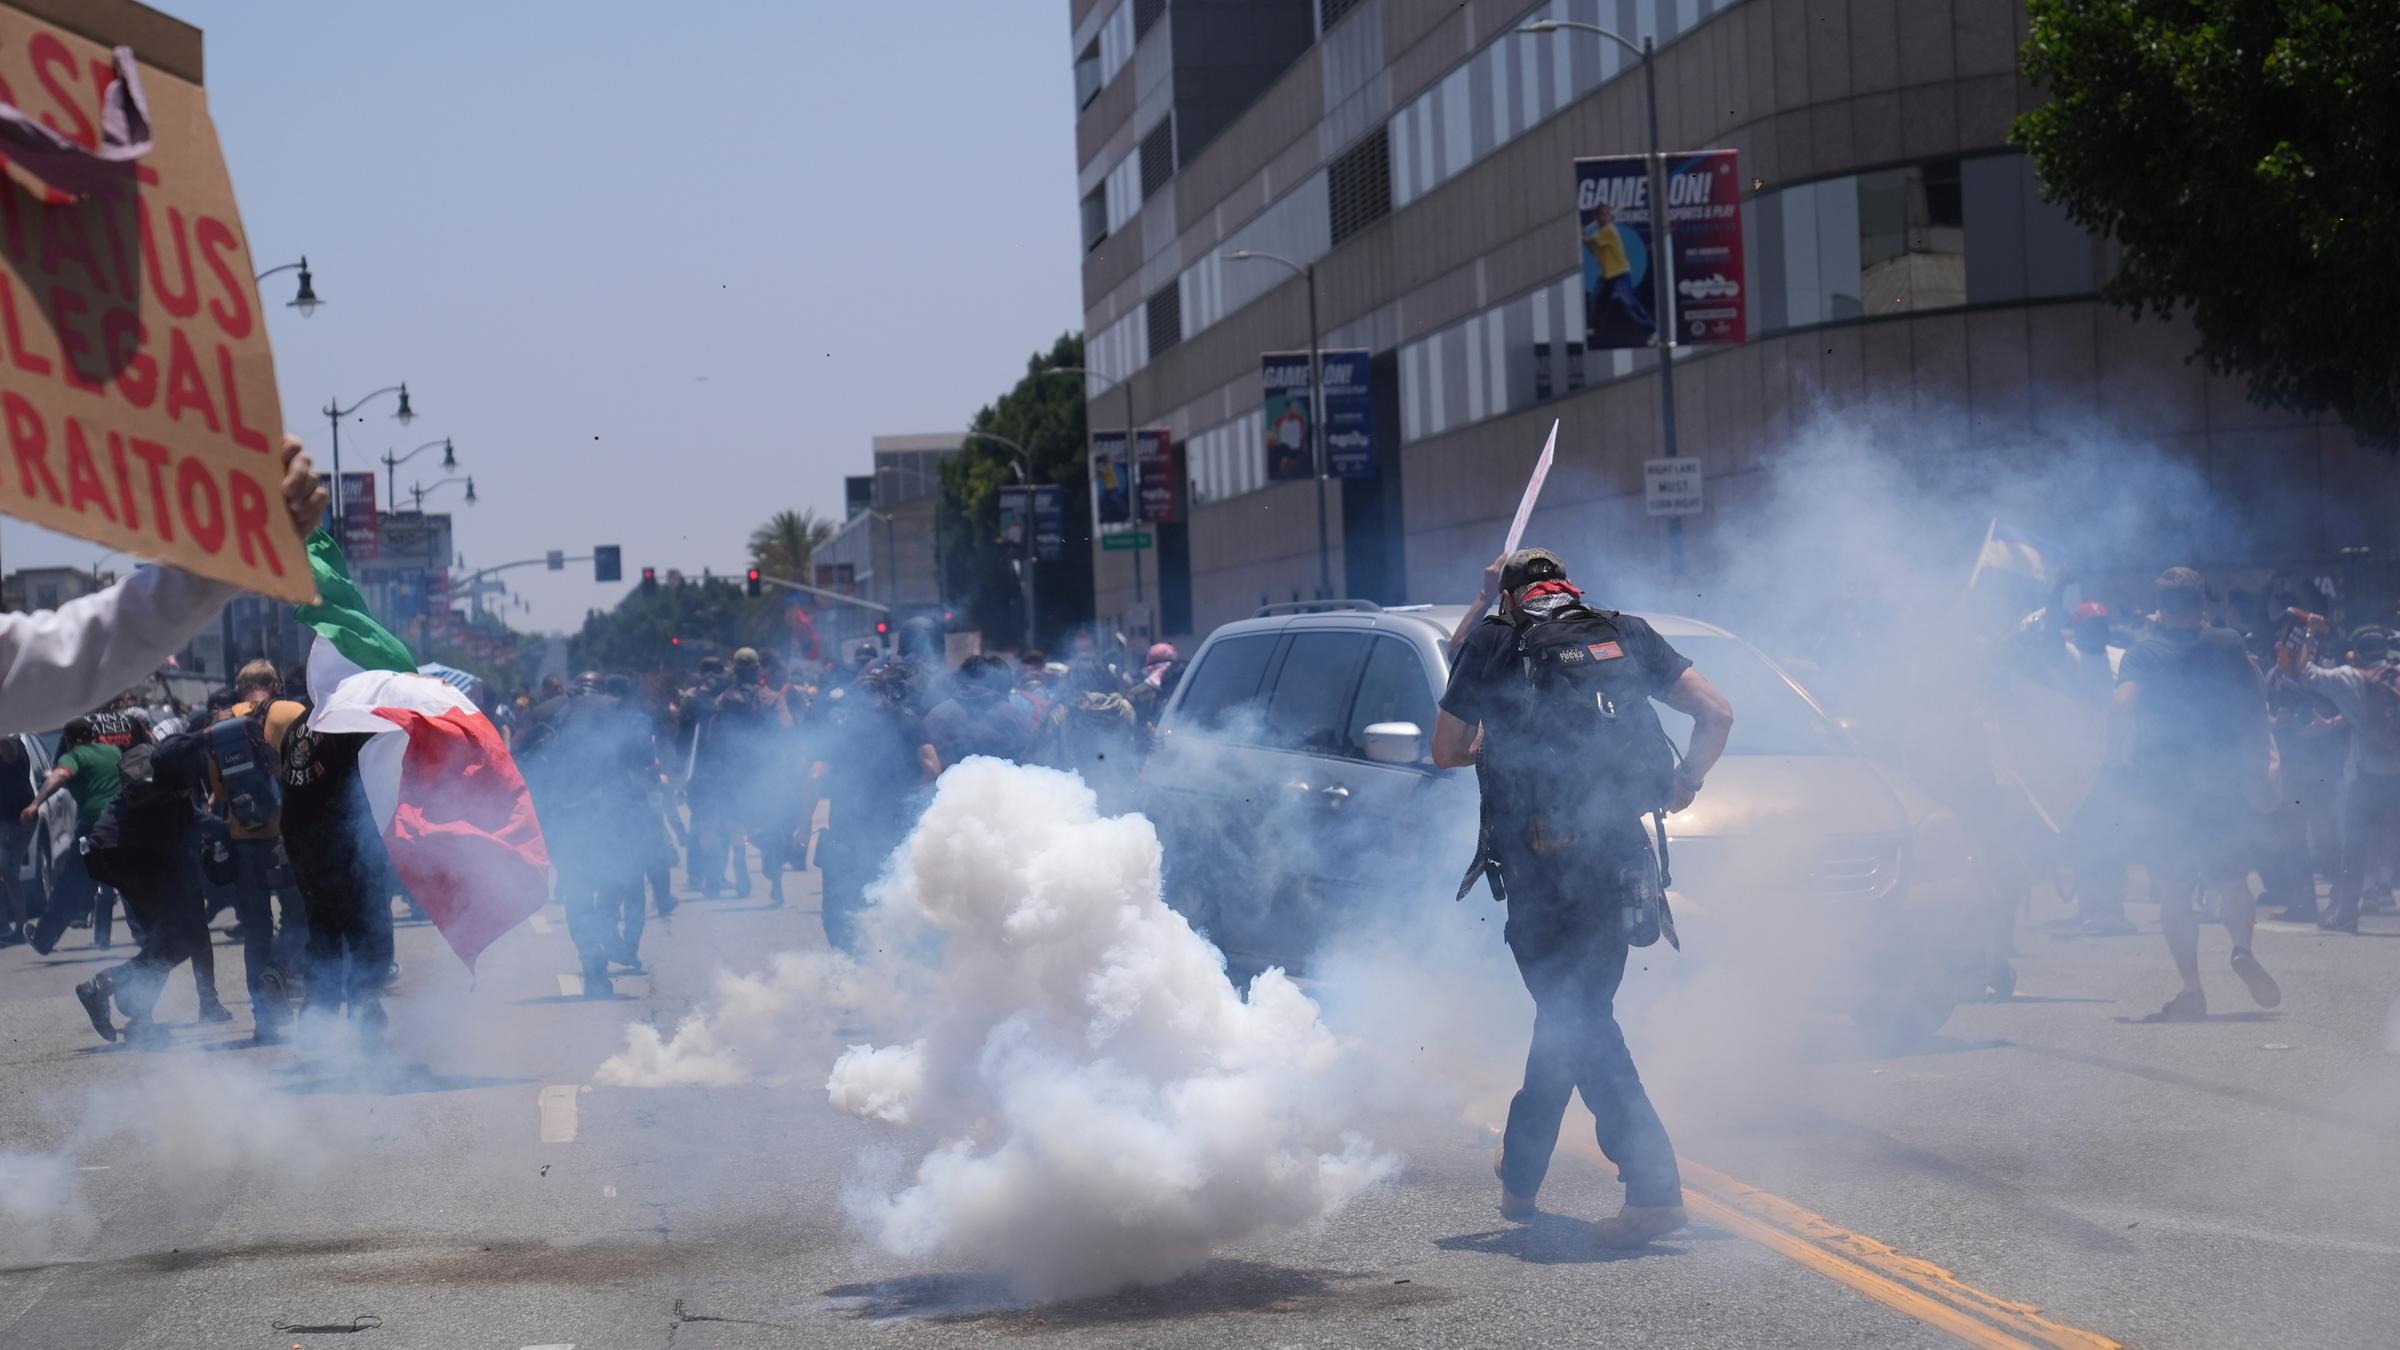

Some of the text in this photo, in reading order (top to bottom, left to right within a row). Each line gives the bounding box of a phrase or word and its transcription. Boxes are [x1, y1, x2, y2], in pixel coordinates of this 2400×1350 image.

[1578, 172, 1713, 210] GAME ON!
[0, 270, 270, 454] LEGAL
[1264, 365, 1310, 387] GAME
[0, 391, 285, 578] RAITOR
[1560, 650, 1584, 661] FUCKS
